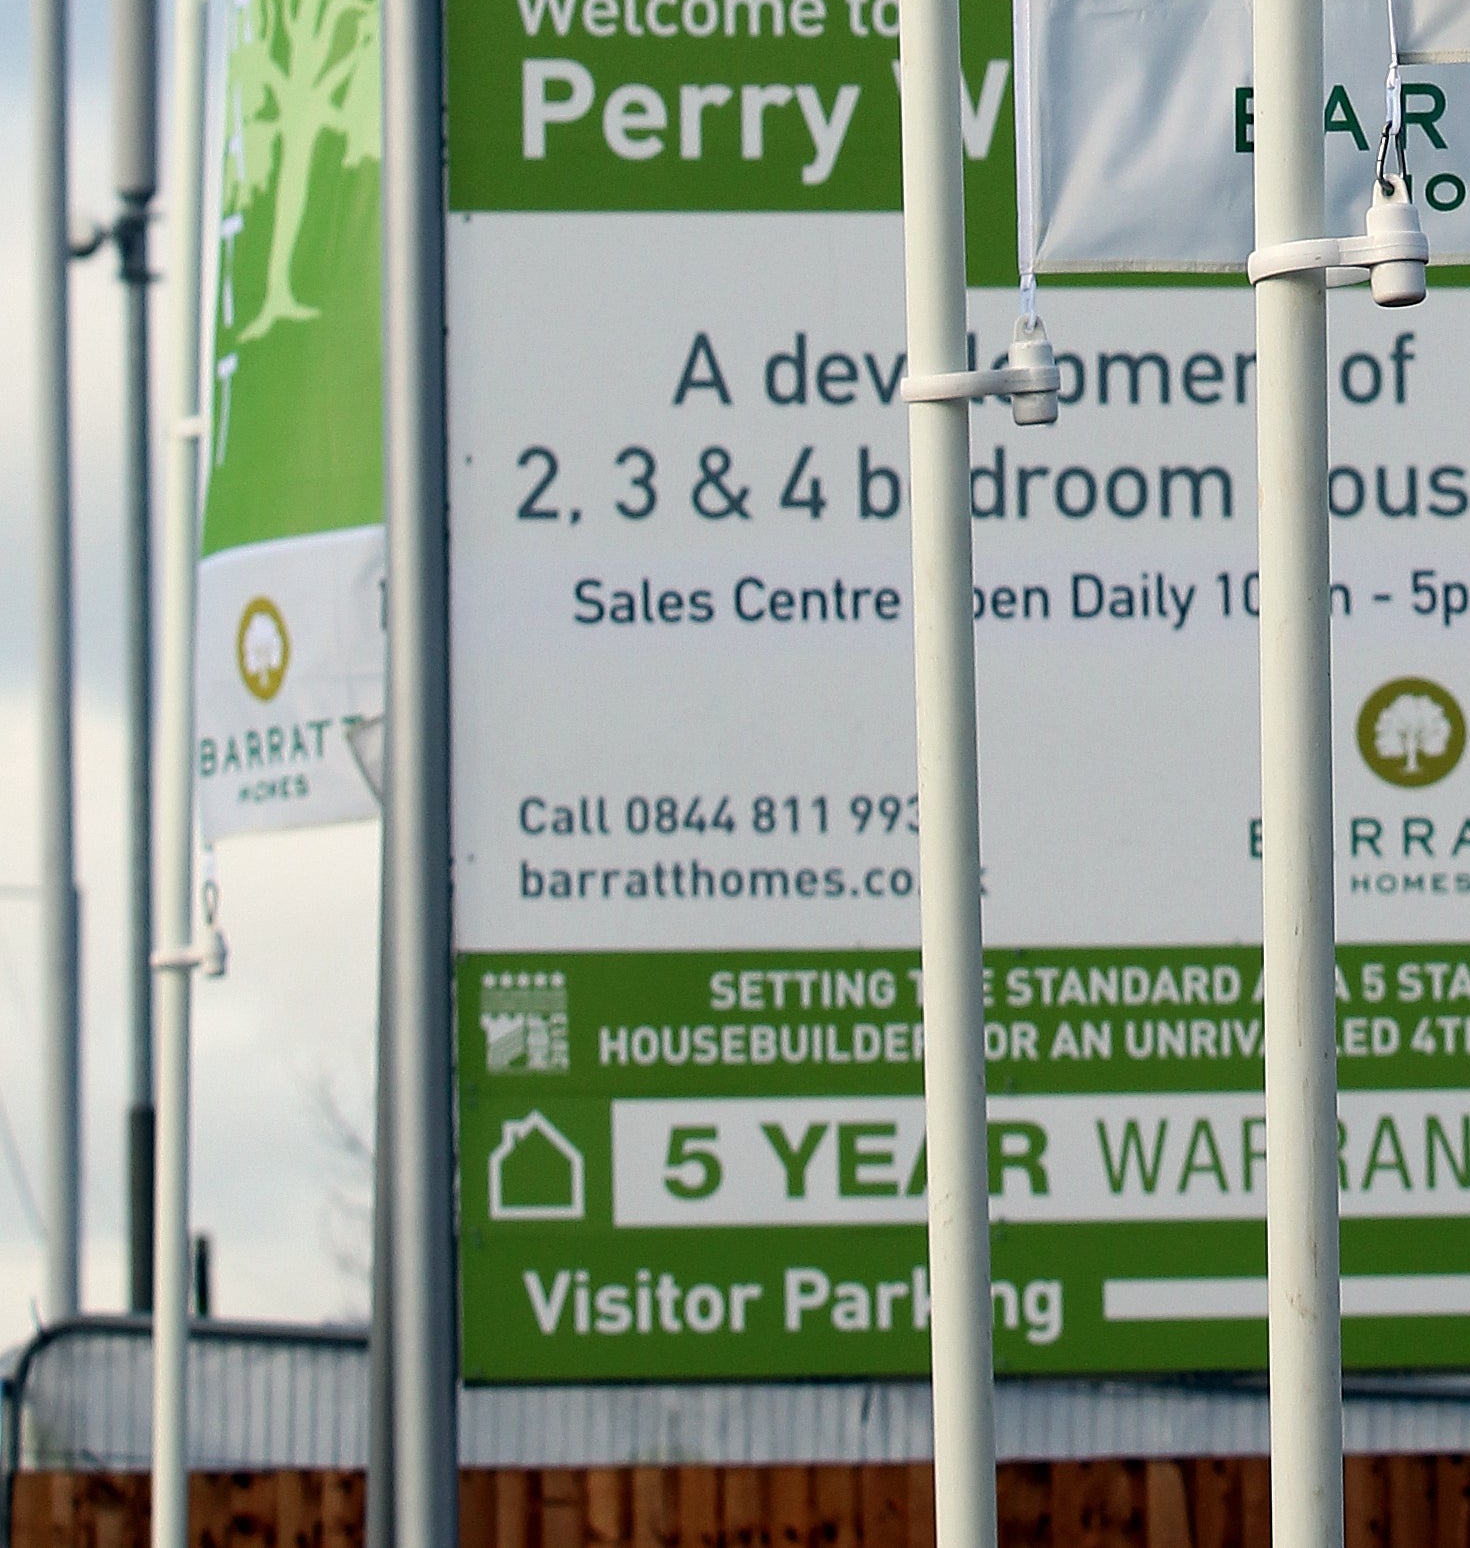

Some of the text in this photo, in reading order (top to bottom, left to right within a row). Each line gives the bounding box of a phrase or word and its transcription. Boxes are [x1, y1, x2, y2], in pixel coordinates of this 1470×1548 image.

[521, 57, 861, 185] Perry
[674, 332, 732, 404] A
[1340, 332, 1416, 404] of
[516, 446, 582, 523] 2,
[614, 446, 658, 520] 3
[692, 446, 752, 520] &
[780, 446, 827, 519] 4
[859, 446, 1234, 519] bdroom
[573, 578, 715, 625] Sales
[734, 576, 900, 622] Centre
[1071, 572, 1195, 628] Daily
[519, 795, 609, 835] Call
[626, 794, 736, 835] 0844
[751, 794, 829, 834] 811
[709, 969, 896, 1011] SETTING
[1006, 966, 1240, 1007] STANDARD
[1362, 964, 1386, 1003] 5
[985, 1021, 1038, 1061] OR
[1049, 1019, 1113, 1059] AN
[663, 1125, 722, 1199] 5
[522, 1266, 1064, 1346] Visitor Parkng
